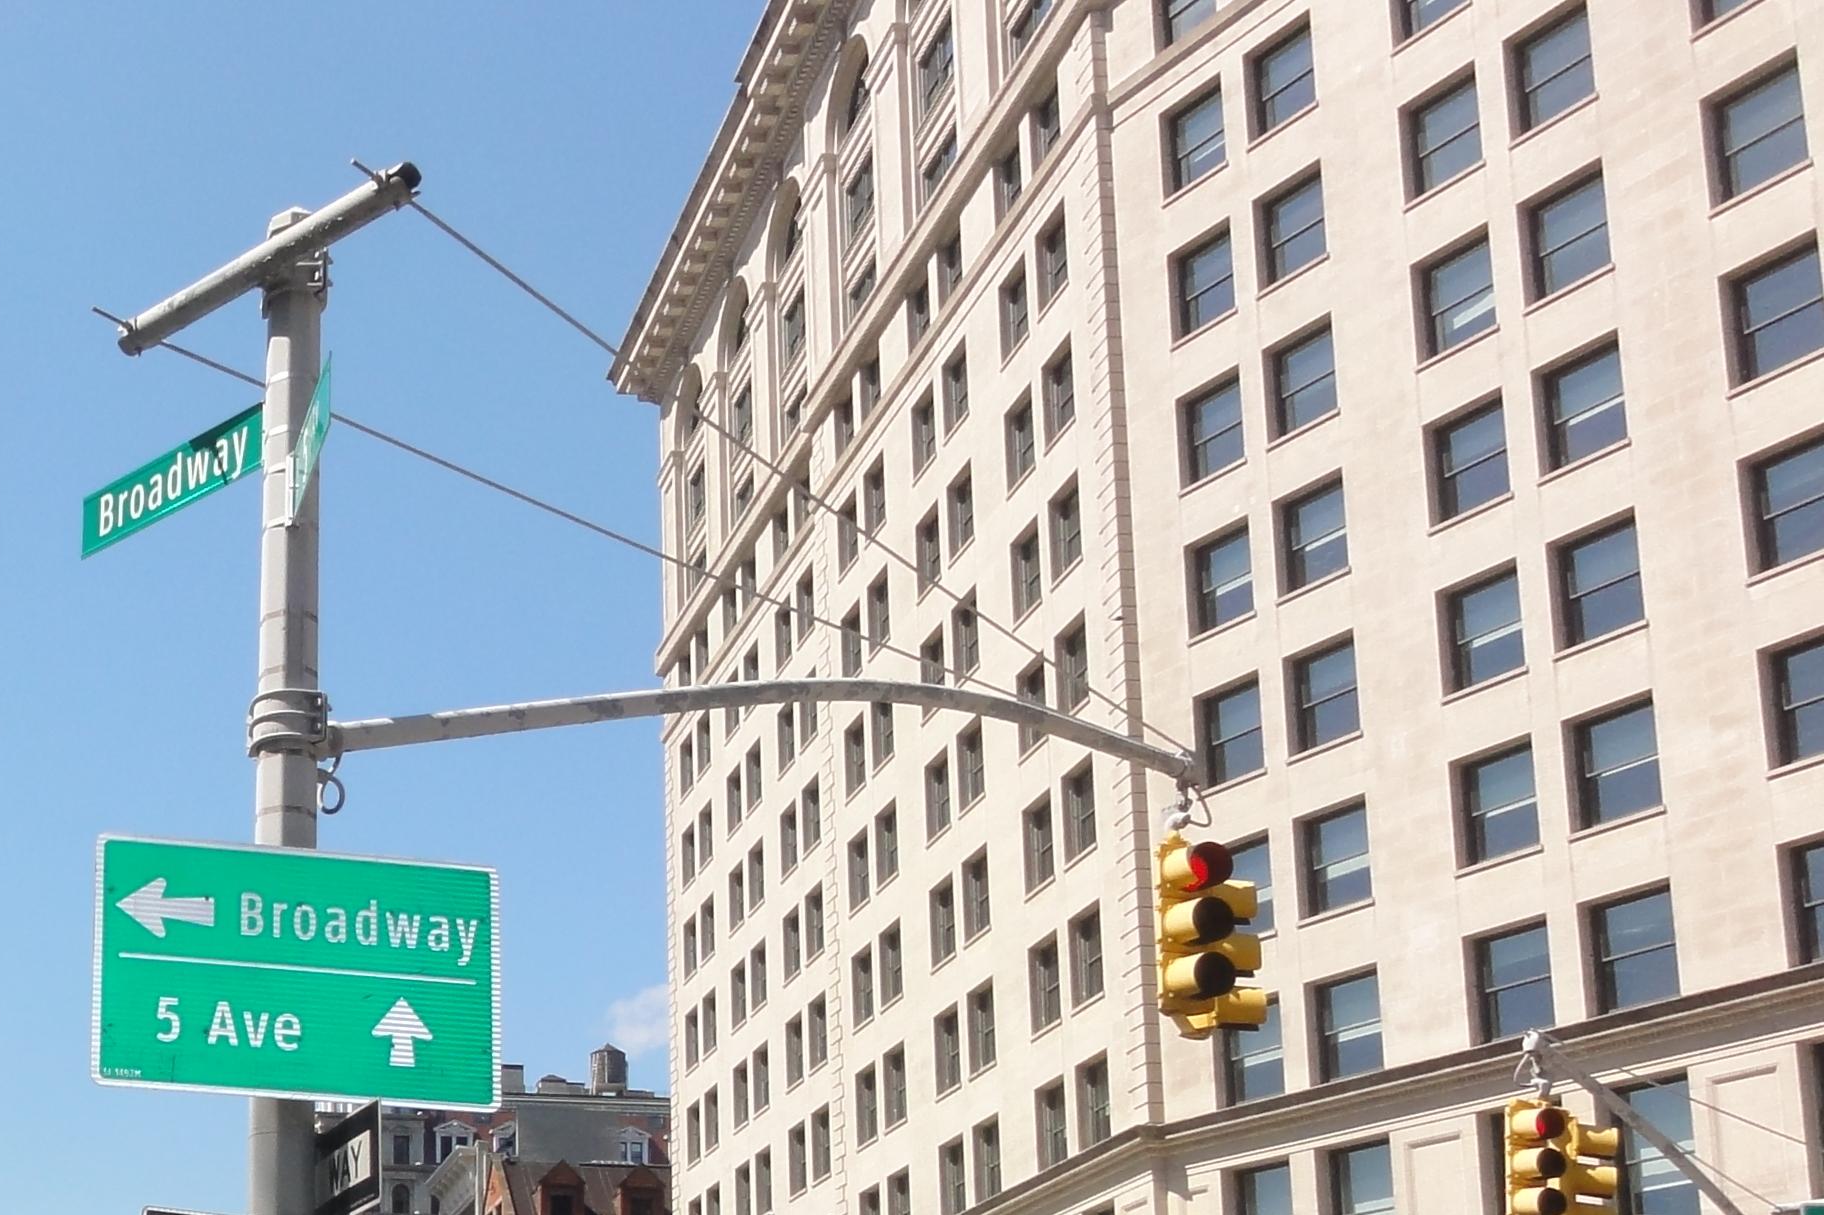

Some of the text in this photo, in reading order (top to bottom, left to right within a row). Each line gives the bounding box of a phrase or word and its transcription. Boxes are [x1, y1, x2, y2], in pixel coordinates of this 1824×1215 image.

[99, 426, 248, 537] Broadway
[239, 891, 481, 967] Broadway
[156, 996, 303, 1052] 5 Ave
[328, 1140, 363, 1196] WAY
